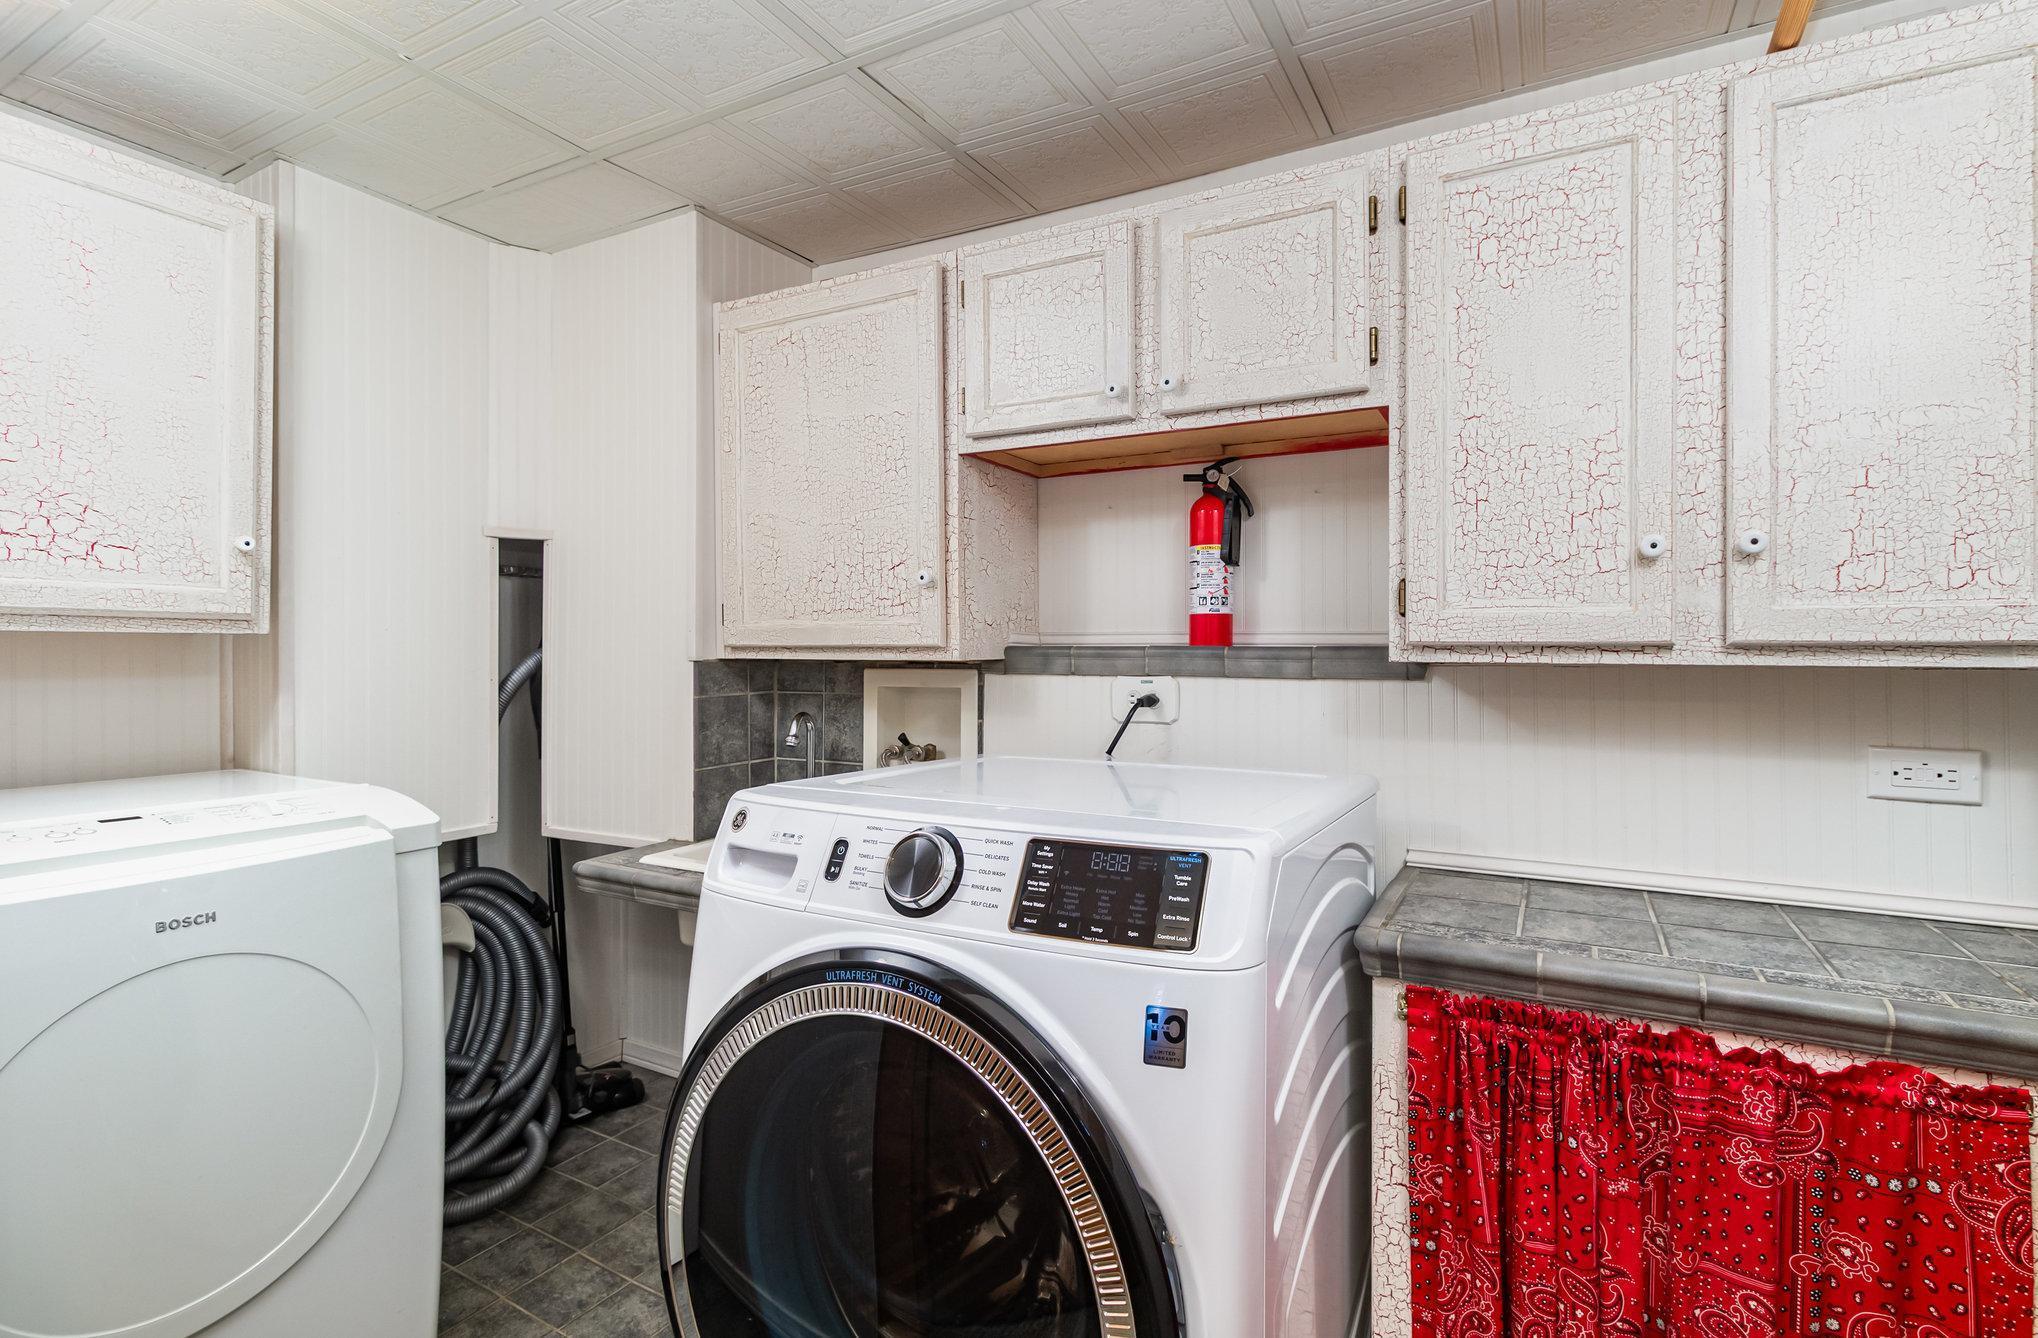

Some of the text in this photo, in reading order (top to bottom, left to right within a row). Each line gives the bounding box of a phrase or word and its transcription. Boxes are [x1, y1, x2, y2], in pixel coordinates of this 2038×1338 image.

[155, 911, 217, 933] BOSCH
[826, 970, 942, 1004] ULTRAFRESH VENT SYSTEM
[1146, 1013, 1185, 1044] 10
